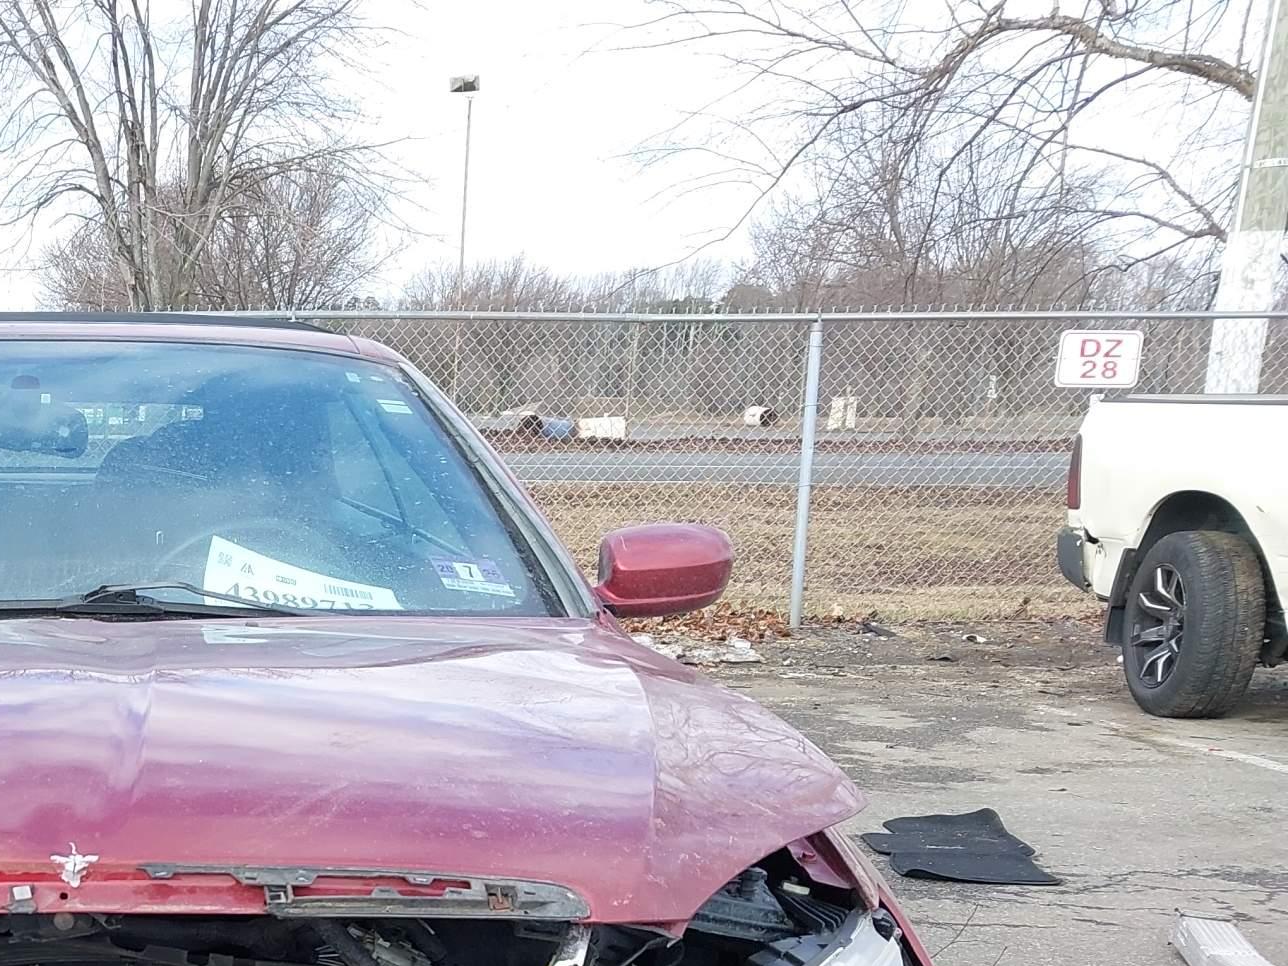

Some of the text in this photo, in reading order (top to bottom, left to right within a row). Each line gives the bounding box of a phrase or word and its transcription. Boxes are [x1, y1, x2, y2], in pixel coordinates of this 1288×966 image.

[1079, 338, 1124, 358] DZ
[1079, 360, 1118, 379] 28
[224, 582, 375, 610] 439897
